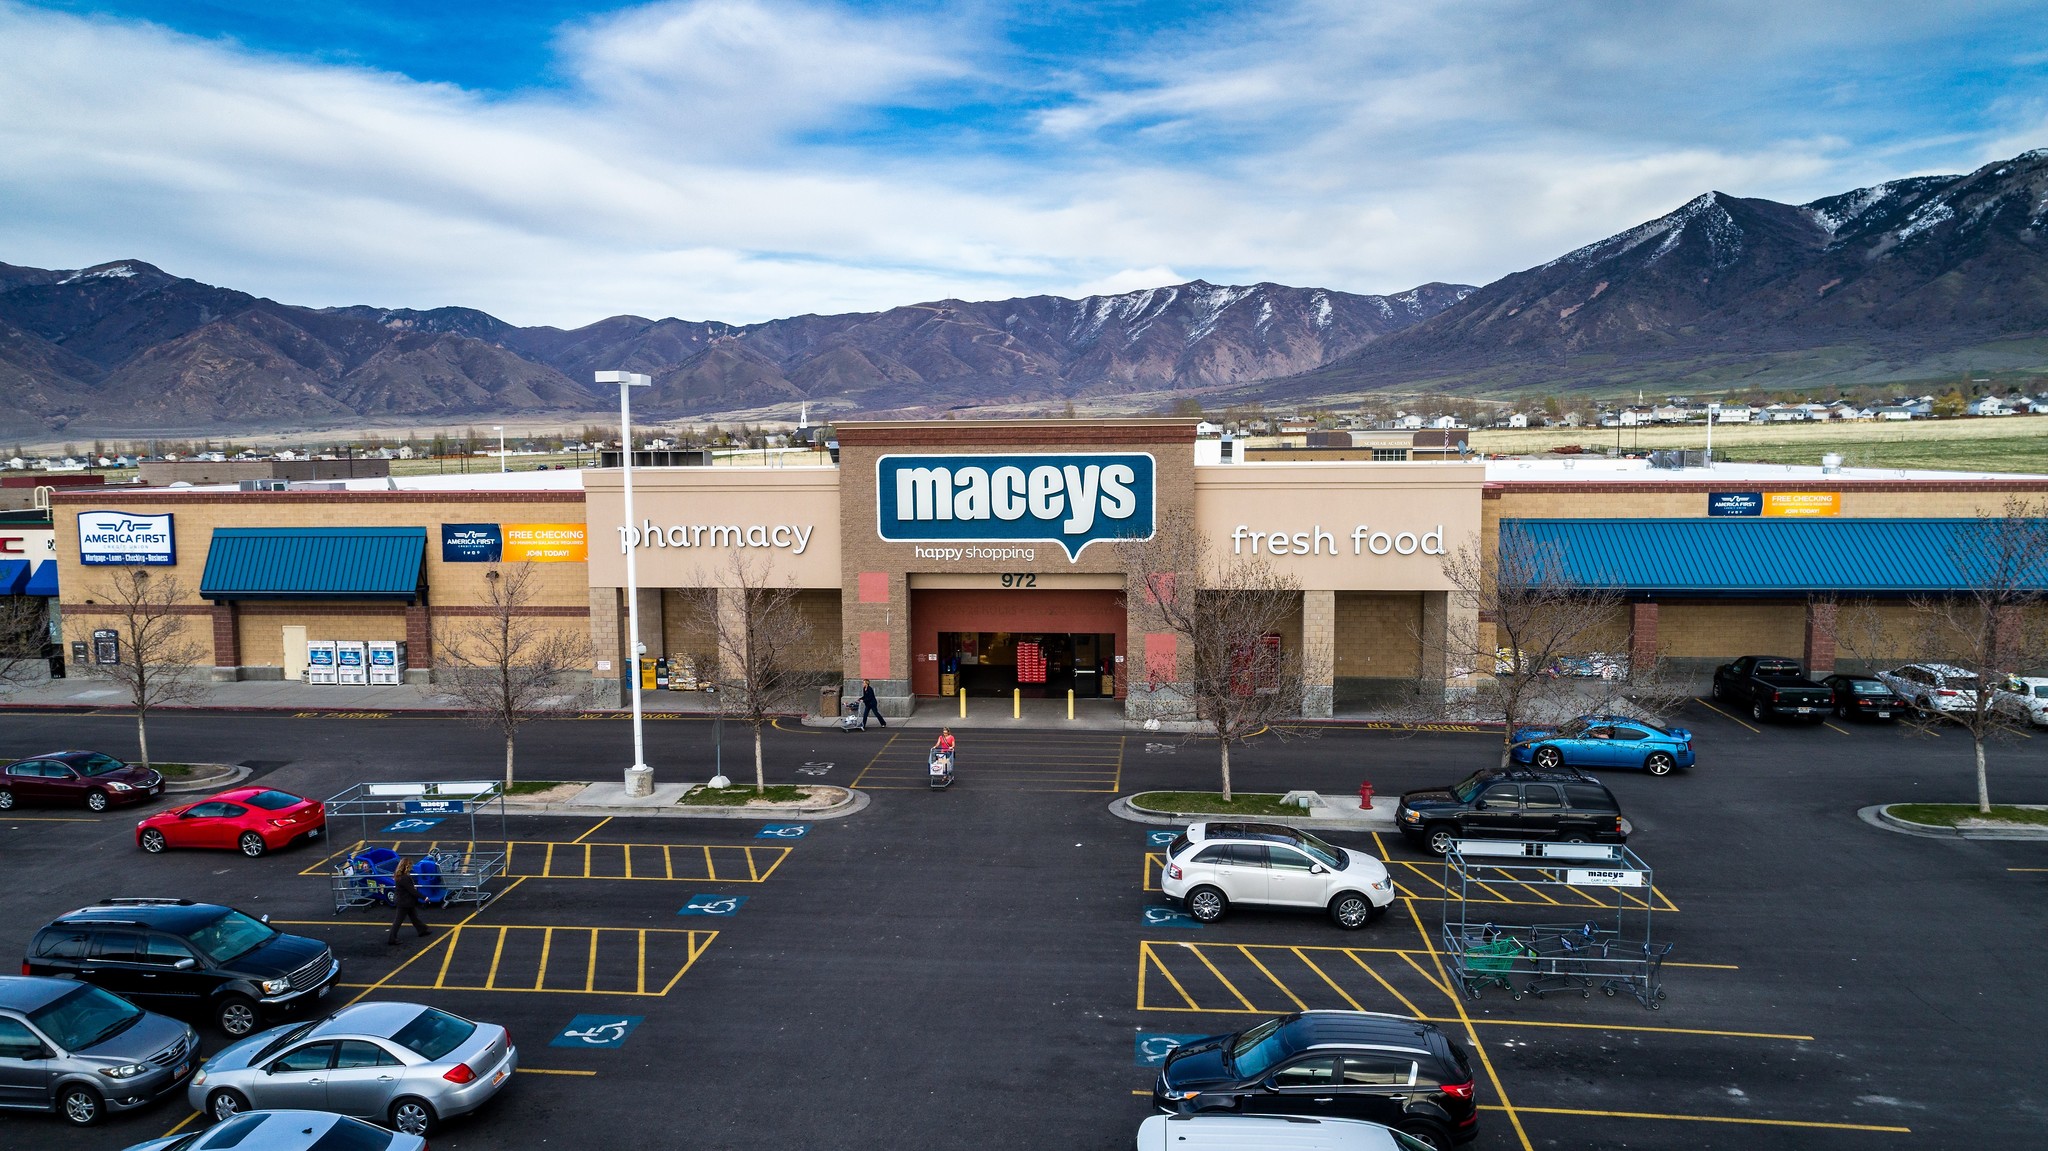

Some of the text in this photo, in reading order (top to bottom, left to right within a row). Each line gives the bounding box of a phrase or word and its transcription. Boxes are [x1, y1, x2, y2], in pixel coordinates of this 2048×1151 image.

[896, 464, 1136, 535] maceys
[85, 534, 166, 543] AMERICA FIRST
[509, 531, 584, 539] FREE CHECKING
[617, 519, 814, 555] pharmacy
[1231, 525, 1446, 556] fresh food
[915, 546, 1035, 561] happy shopping
[1001, 573, 1037, 588] 972
[1402, 723, 1479, 732] PARKING
[1588, 871, 1624, 879] maceys
